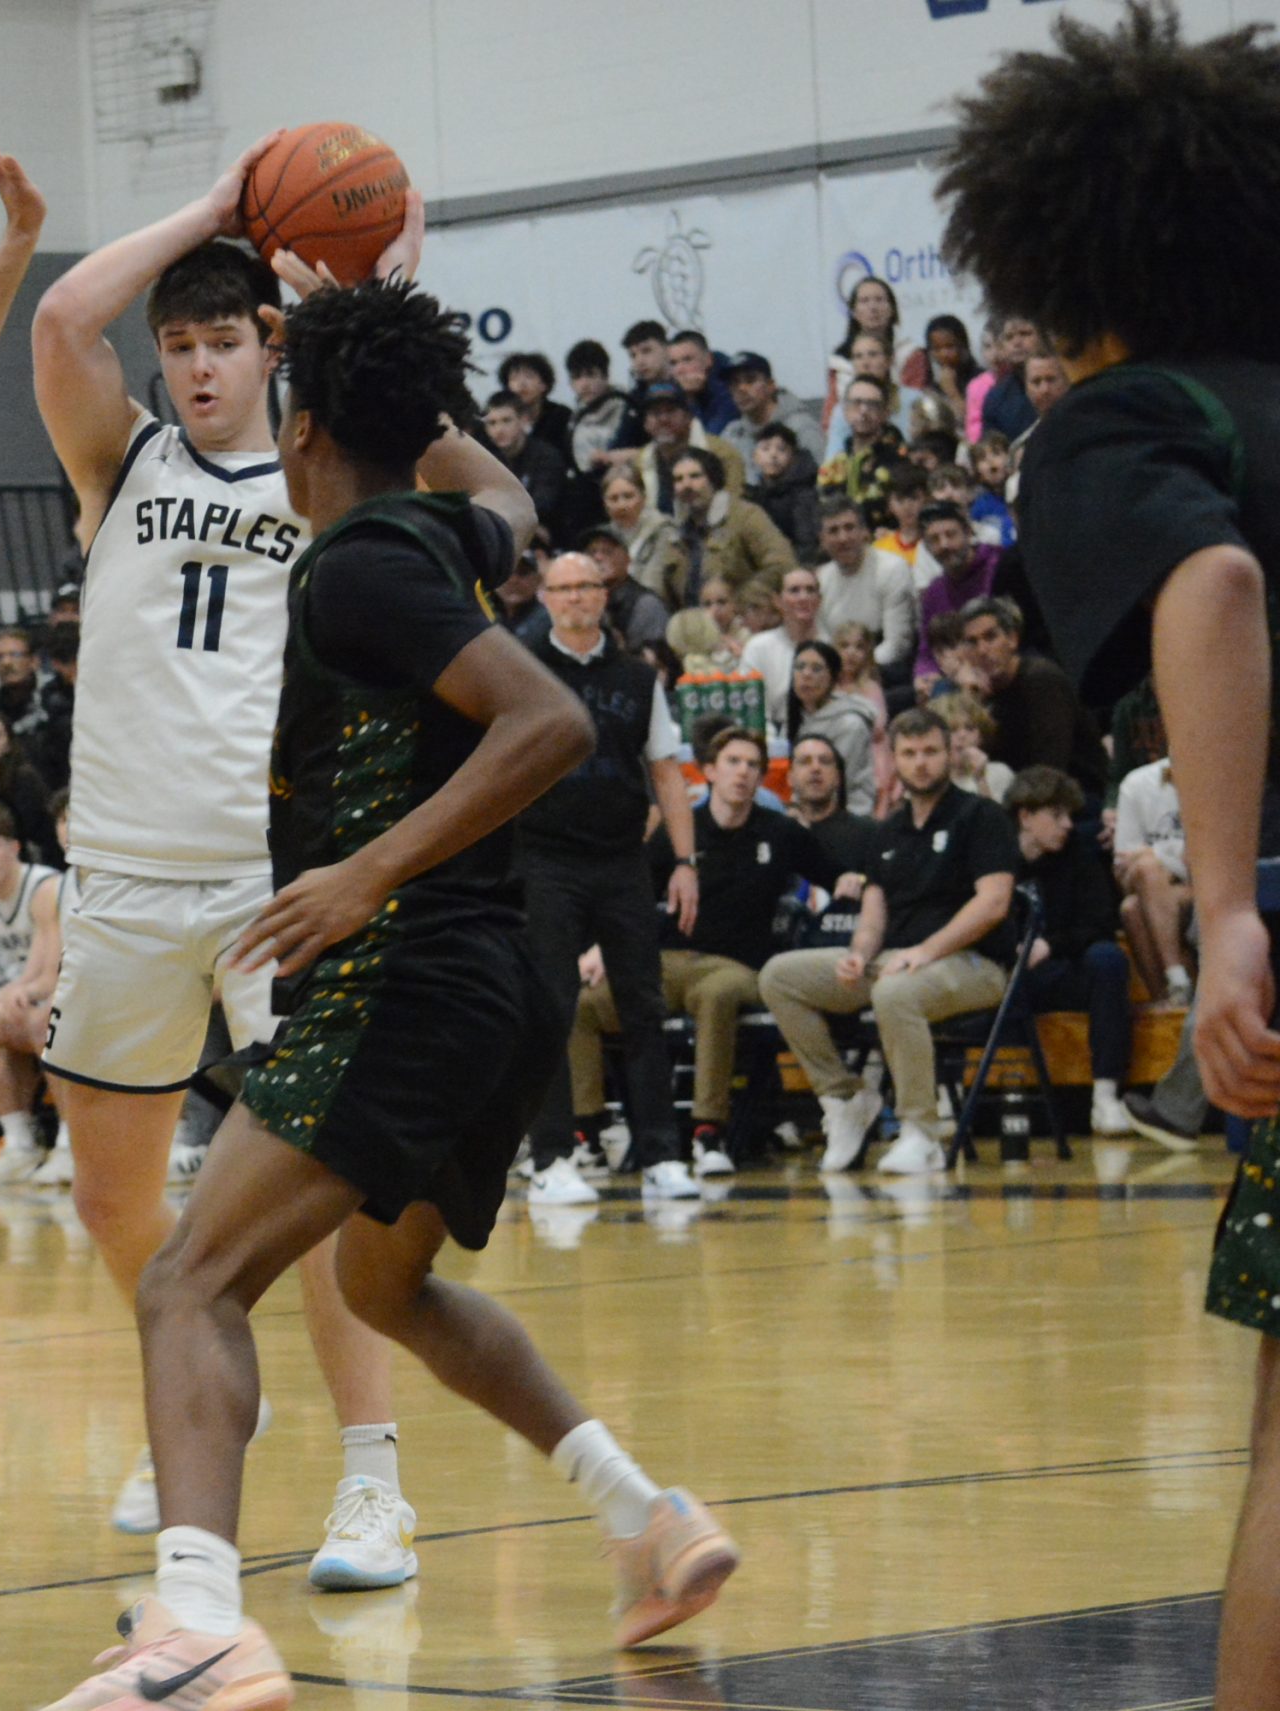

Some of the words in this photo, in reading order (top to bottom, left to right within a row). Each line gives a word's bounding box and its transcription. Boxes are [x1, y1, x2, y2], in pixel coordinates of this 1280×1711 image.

[886, 244, 954, 282] Orth
[136, 497, 301, 564] STAPLES
[177, 561, 229, 652] 11
